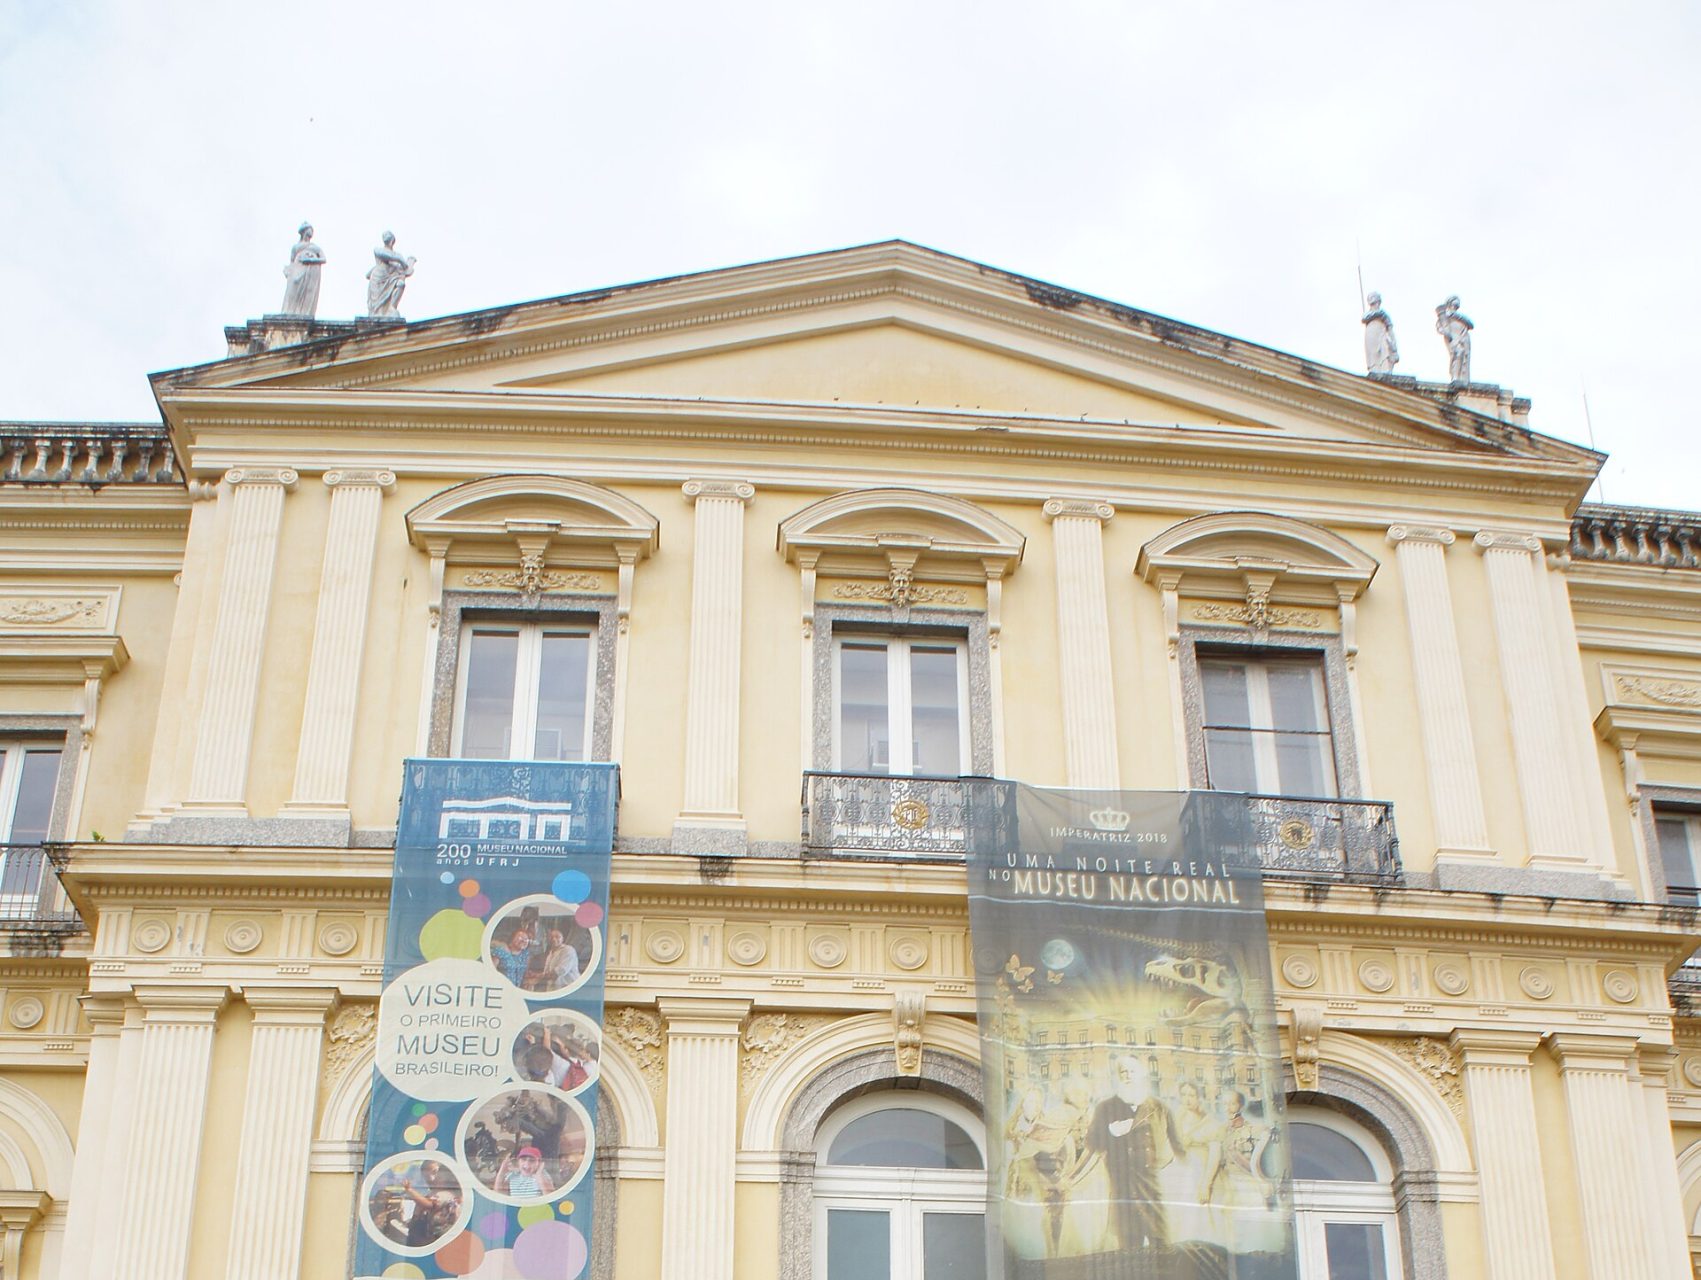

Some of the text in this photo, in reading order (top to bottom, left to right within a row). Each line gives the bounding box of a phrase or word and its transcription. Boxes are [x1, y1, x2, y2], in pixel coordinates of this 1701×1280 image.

[1050, 826, 1168, 844] IMPERATRIZ 2018
[437, 843, 567, 859] 200 MUSEU NACIONAL
[436, 857, 520, 867] anos UFRJ
[1007, 852, 1230, 878] UMA NOITE REAL
[988, 868, 1240, 904] NO MUSEU NACIONAL
[404, 983, 504, 1010] VISITE
[400, 1013, 502, 1030] O PRIMEIRO
[397, 1033, 501, 1057] MUSEU
[395, 1061, 499, 1077] BRASILEIRO!
